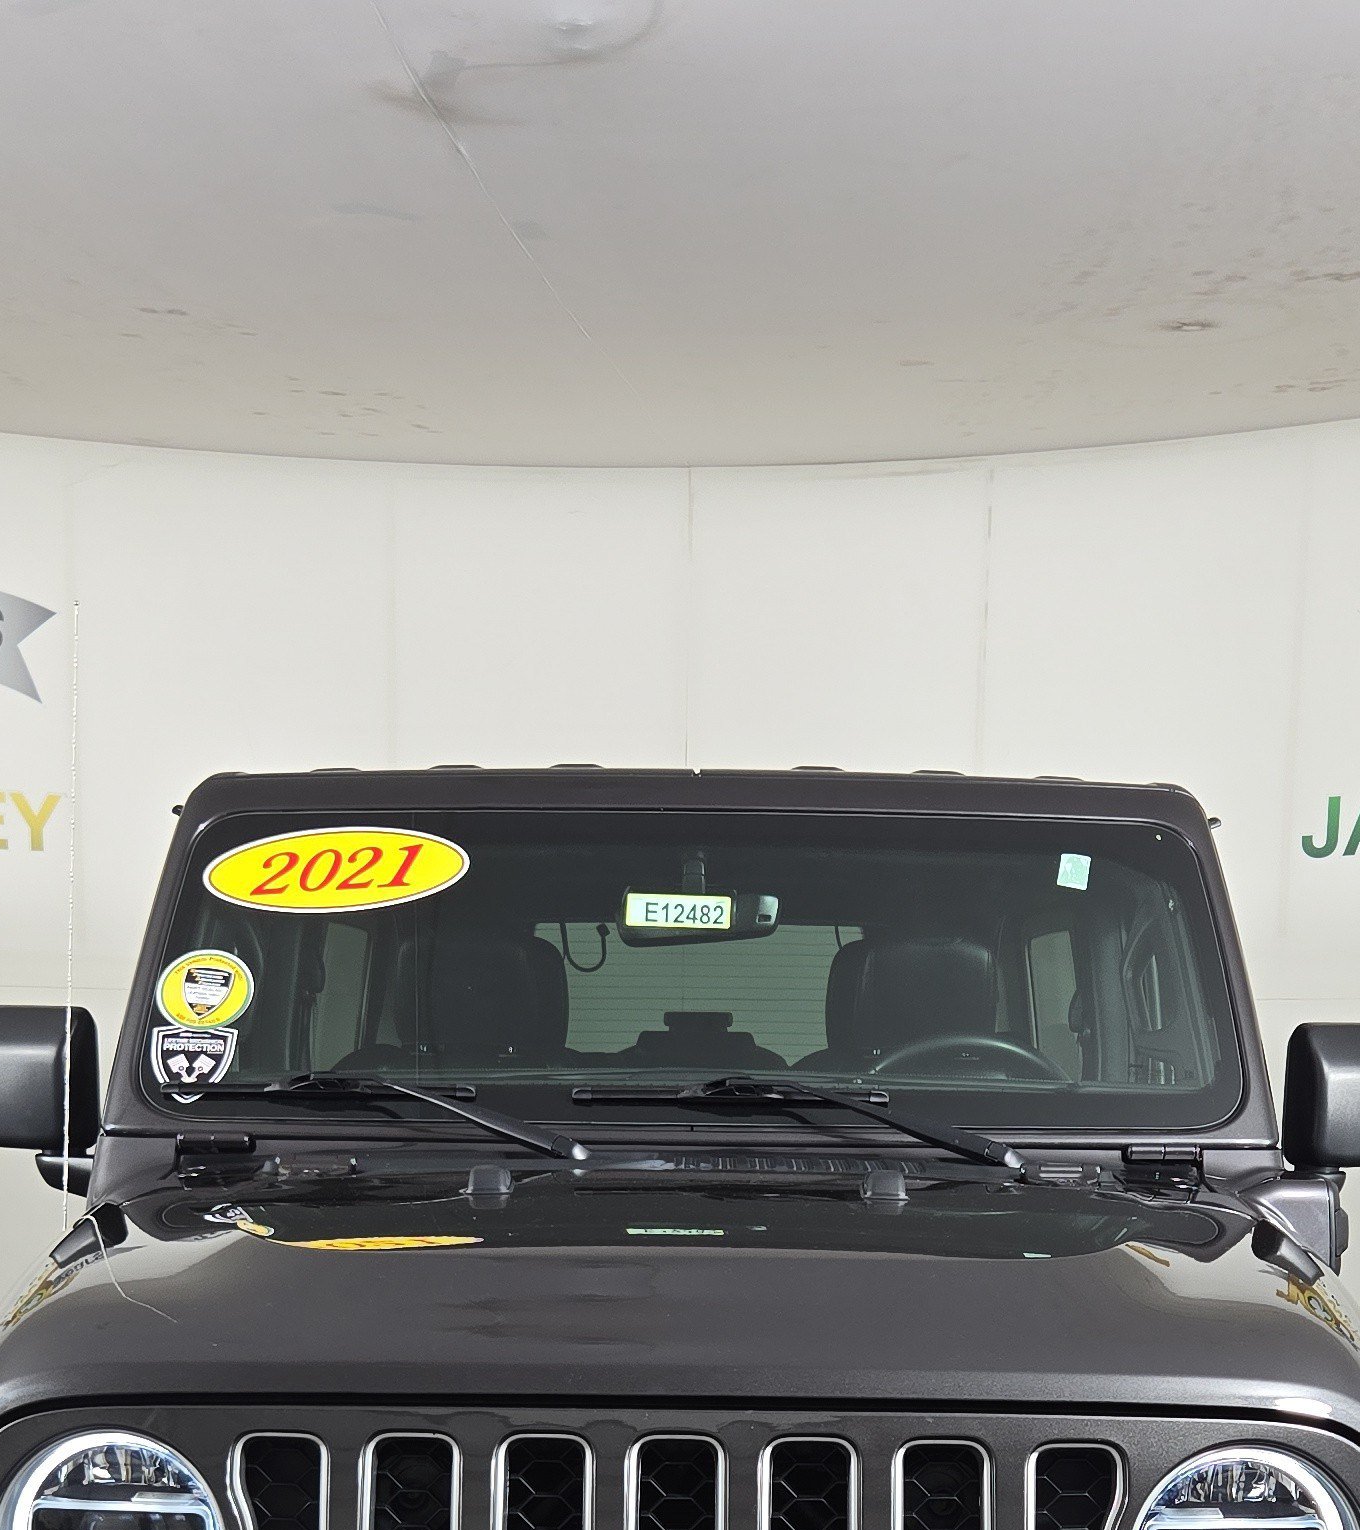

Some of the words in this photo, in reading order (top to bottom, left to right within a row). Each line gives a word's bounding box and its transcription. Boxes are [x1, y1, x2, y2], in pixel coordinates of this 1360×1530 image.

[249, 843, 424, 896] 2021
[644, 901, 725, 925] E12482
[162, 1042, 225, 1052] PROTECTION
